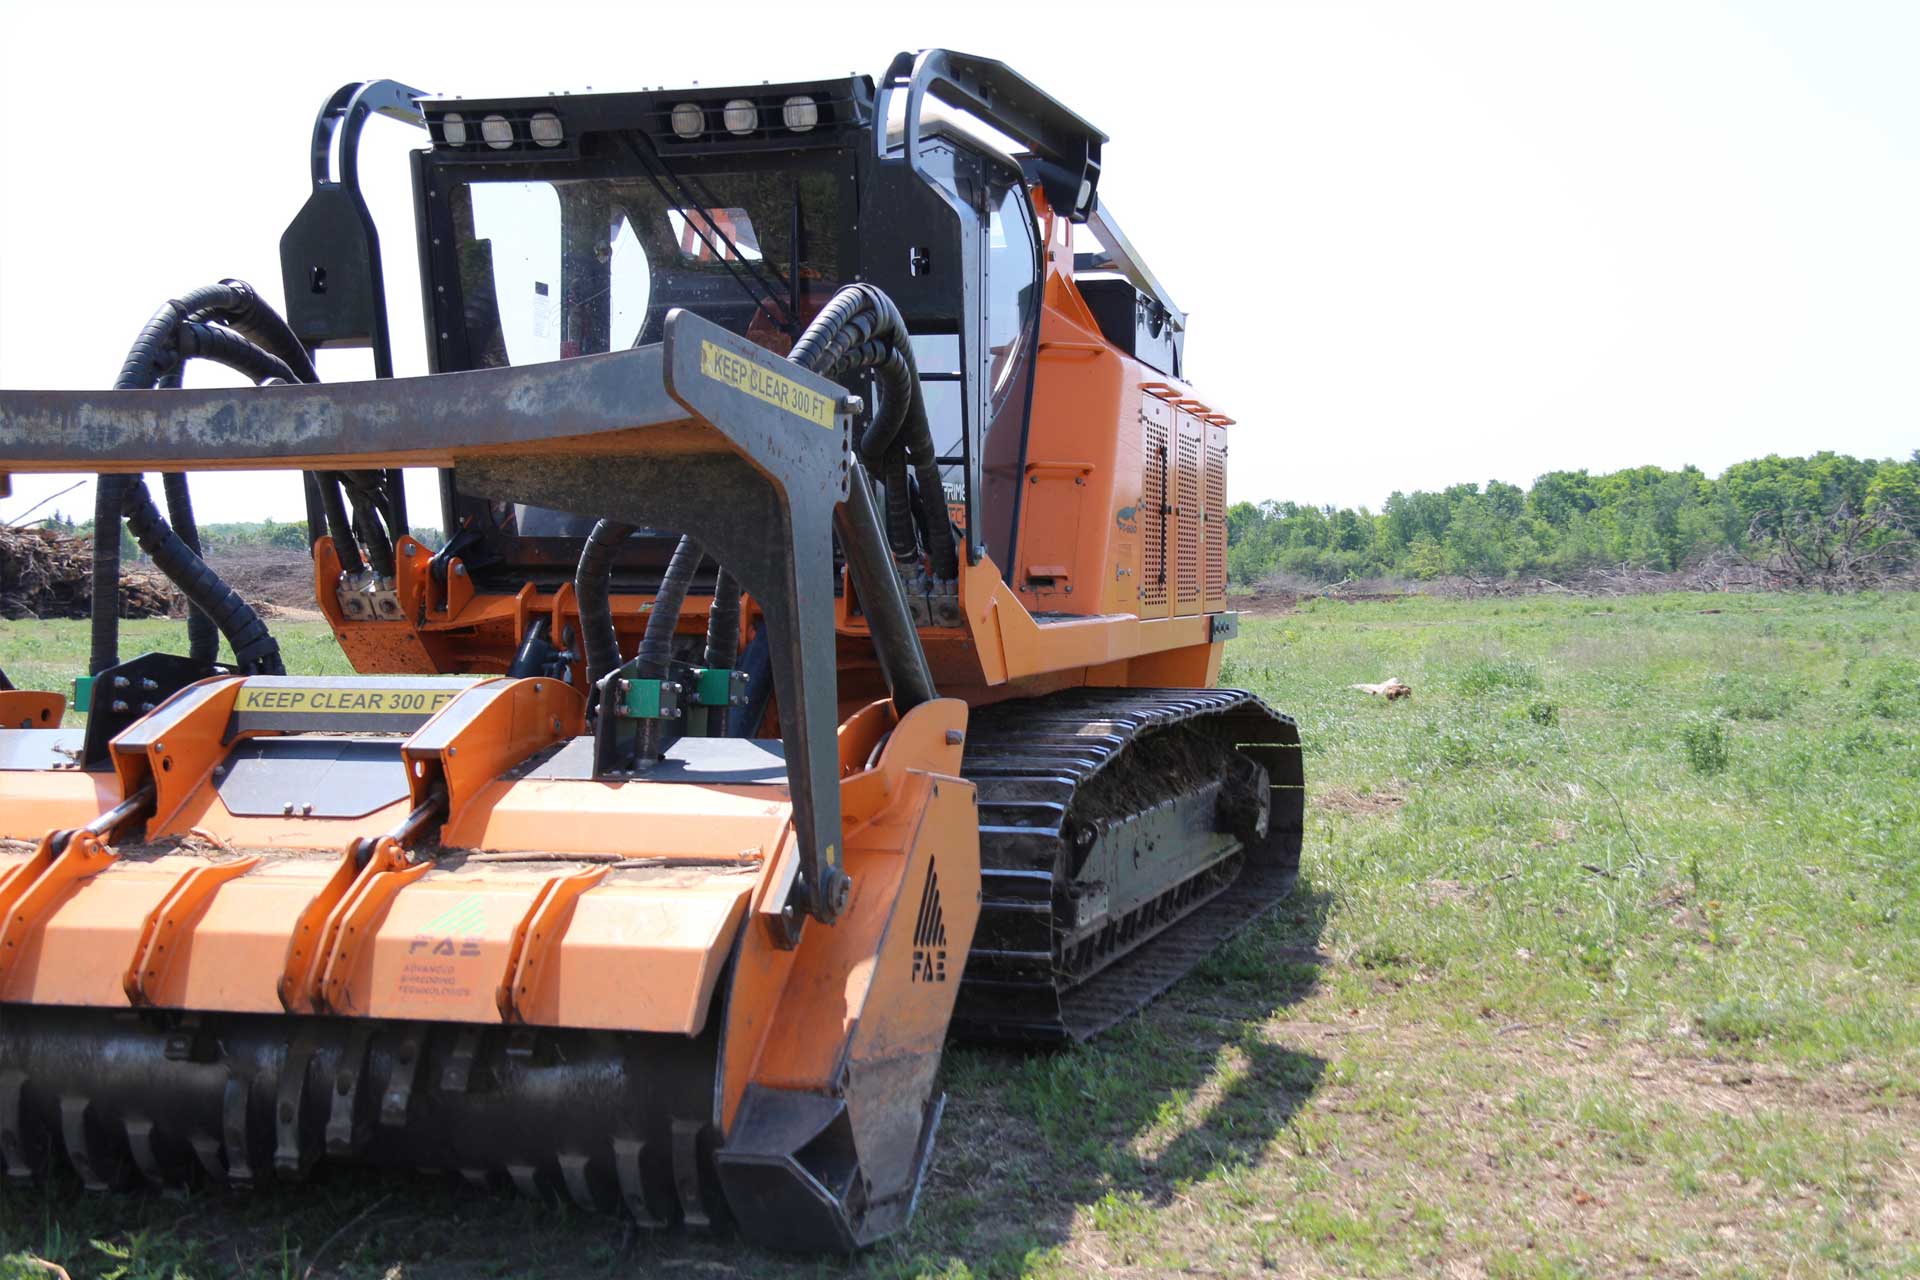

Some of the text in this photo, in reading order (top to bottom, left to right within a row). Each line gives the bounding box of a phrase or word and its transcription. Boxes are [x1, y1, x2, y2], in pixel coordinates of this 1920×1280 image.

[714, 351, 825, 421] KEEP CLEAR 300 FT
[247, 691, 304, 708] KEEP
[310, 692, 382, 710] CLEAR
[389, 693, 425, 710] 300
[911, 951, 946, 983] FAE
